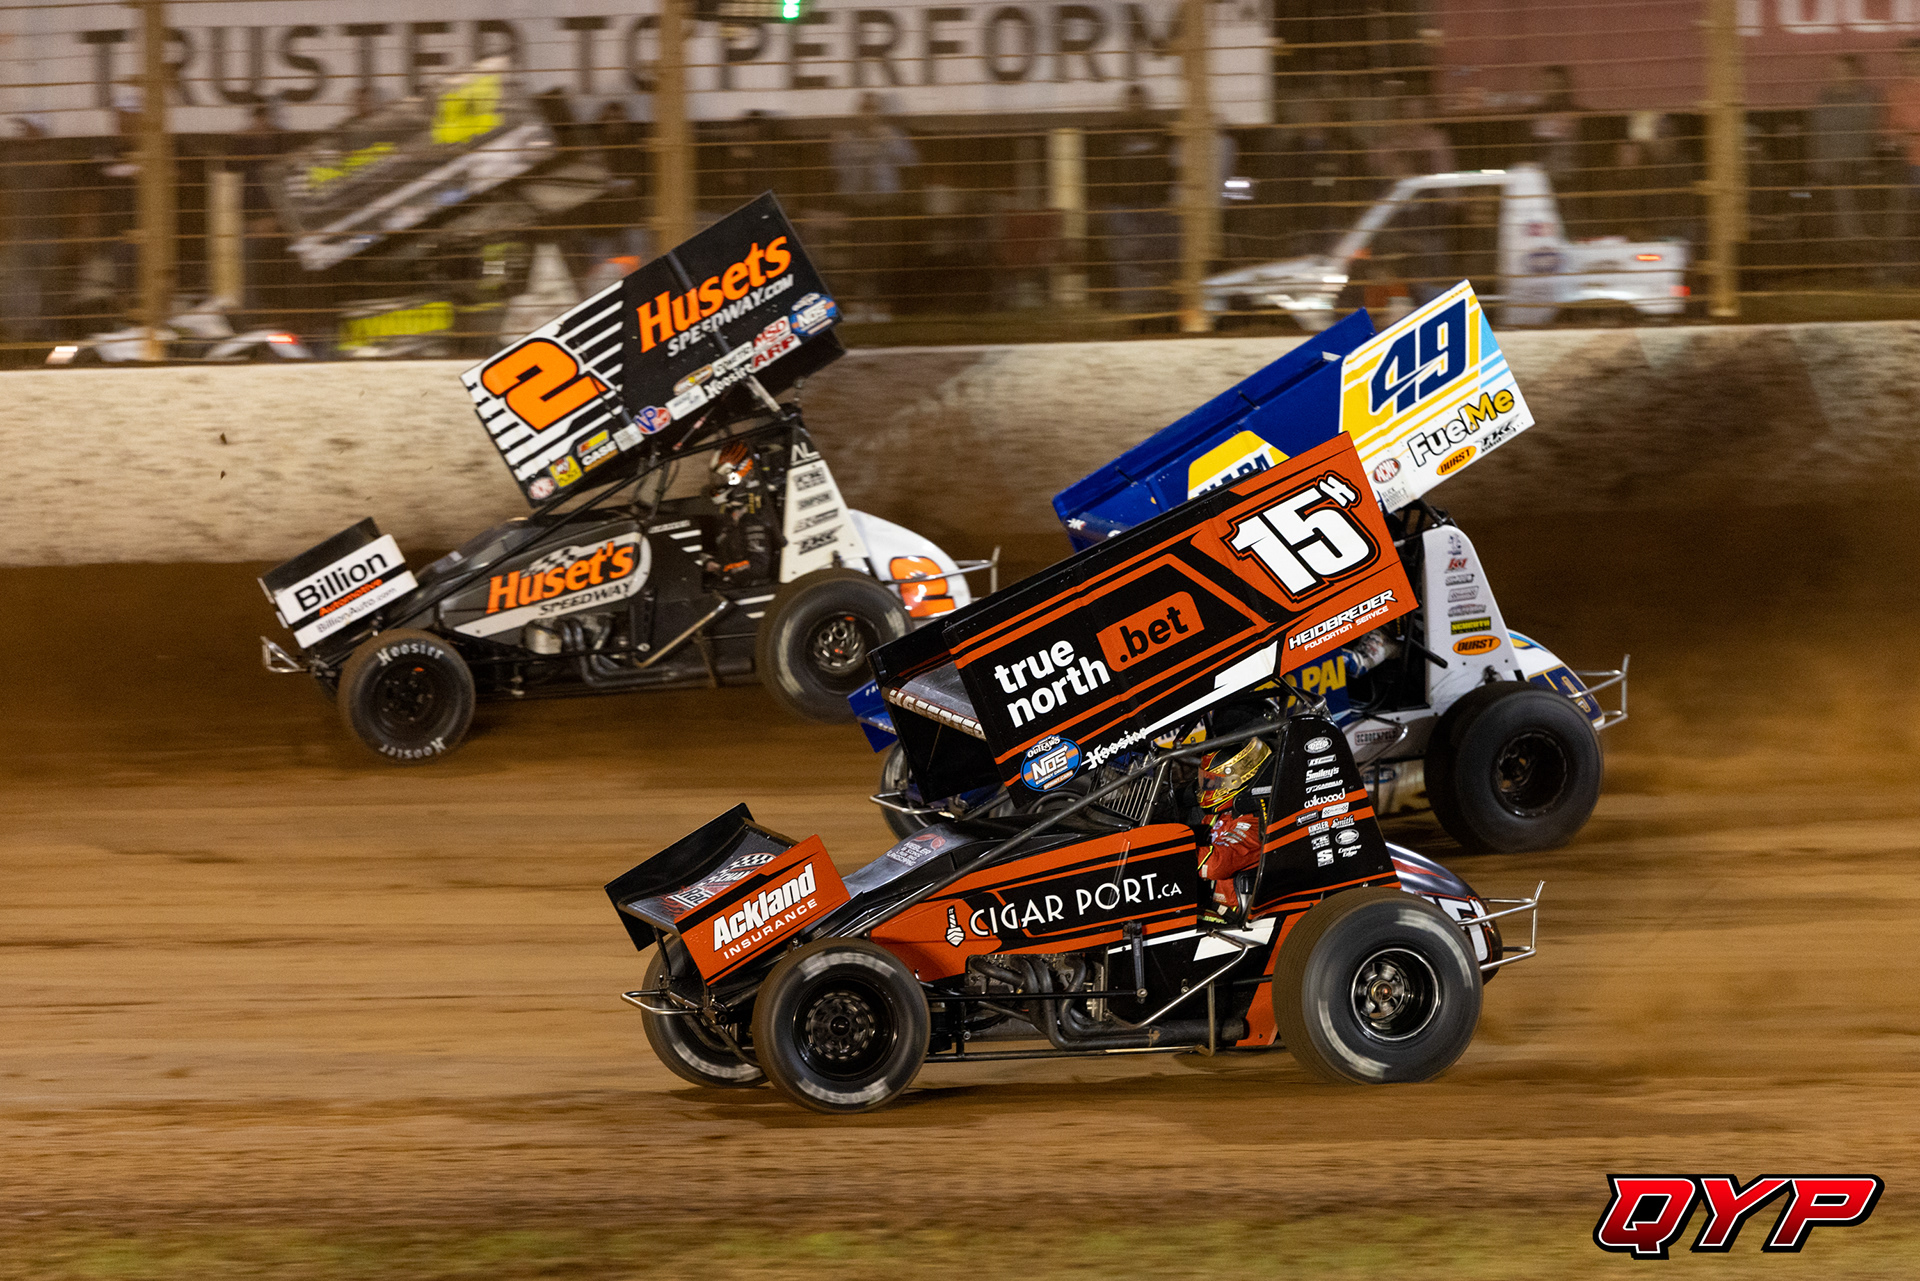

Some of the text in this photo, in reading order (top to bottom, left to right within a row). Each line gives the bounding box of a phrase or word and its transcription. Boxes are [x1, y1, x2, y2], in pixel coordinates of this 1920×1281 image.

[716, 0, 1192, 92] PERFORM
[636, 235, 792, 353] Husets
[667, 273, 794, 357] SPEEDWAY.COM
[754, 335, 795, 368] ARP
[1371, 298, 1468, 415] 49
[481, 338, 608, 431] 2
[1407, 388, 1515, 468] FuelMe
[1374, 459, 1400, 483] ACME
[1440, 448, 1471, 473] DURST
[294, 552, 389, 612] Billion
[319, 579, 384, 617] Automotive
[486, 541, 635, 614] Huset's
[538, 580, 634, 616] SPEEDWAY
[316, 587, 398, 634] BillionAuto.com
[1118, 606, 1190, 663] .bet
[1289, 588, 1398, 650] HEIDBREDER
[1304, 605, 1389, 651] FOUNDATION SERVICE
[994, 640, 1075, 694] true
[1457, 637, 1496, 652] DURST
[1006, 656, 1111, 728] north
[1031, 744, 1069, 781] NOS
[1083, 730, 1149, 771] Hoosier
[1305, 767, 1340, 781] Smiley's
[1304, 788, 1346, 809] wilwood
[713, 862, 818, 952] Ackland
[723, 898, 818, 959] INSURANCE
[969, 873, 1183, 937] CIGAR PORT.CA
